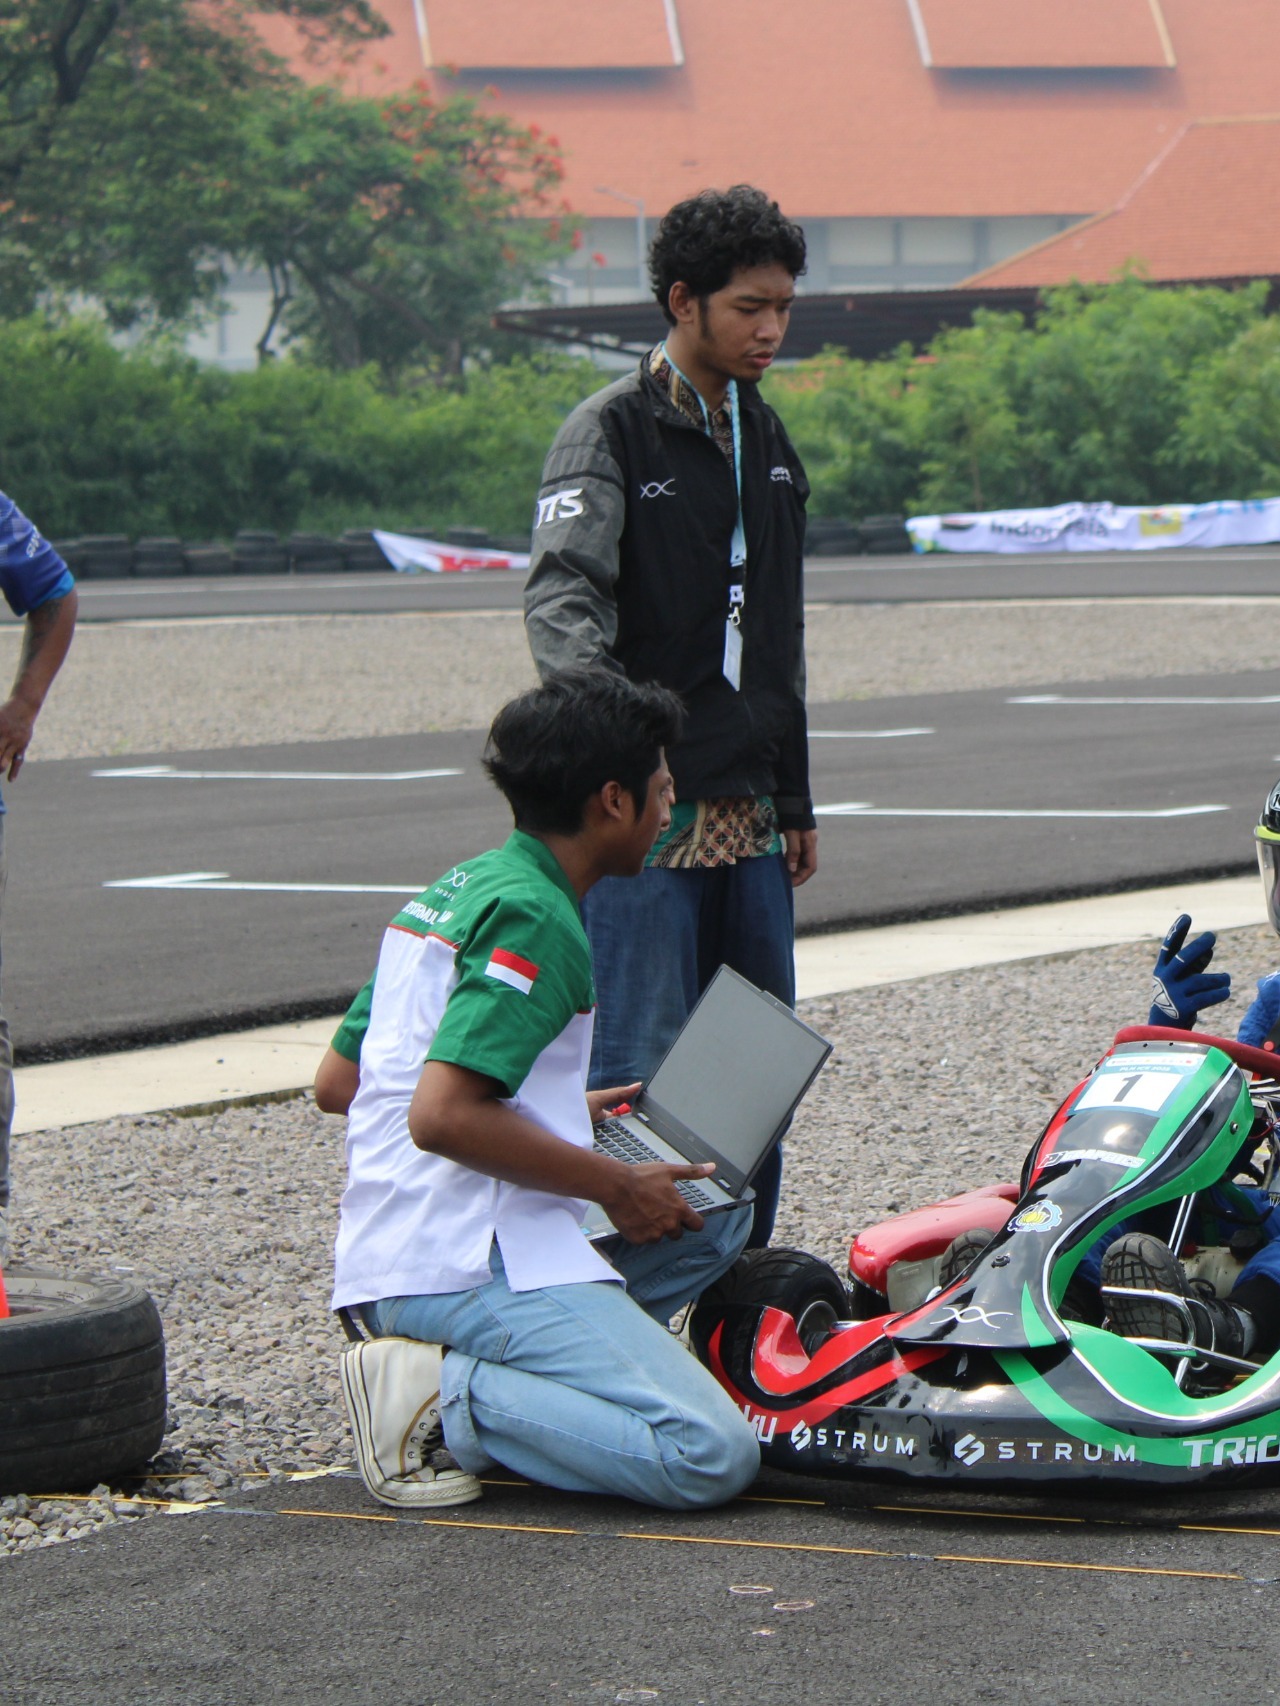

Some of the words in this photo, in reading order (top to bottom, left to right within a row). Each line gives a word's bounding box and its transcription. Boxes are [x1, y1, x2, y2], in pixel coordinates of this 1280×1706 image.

[1113, 1074, 1144, 1103] 1
[816, 1428, 915, 1456] STRUM
[998, 1441, 1136, 1463] STRUM
